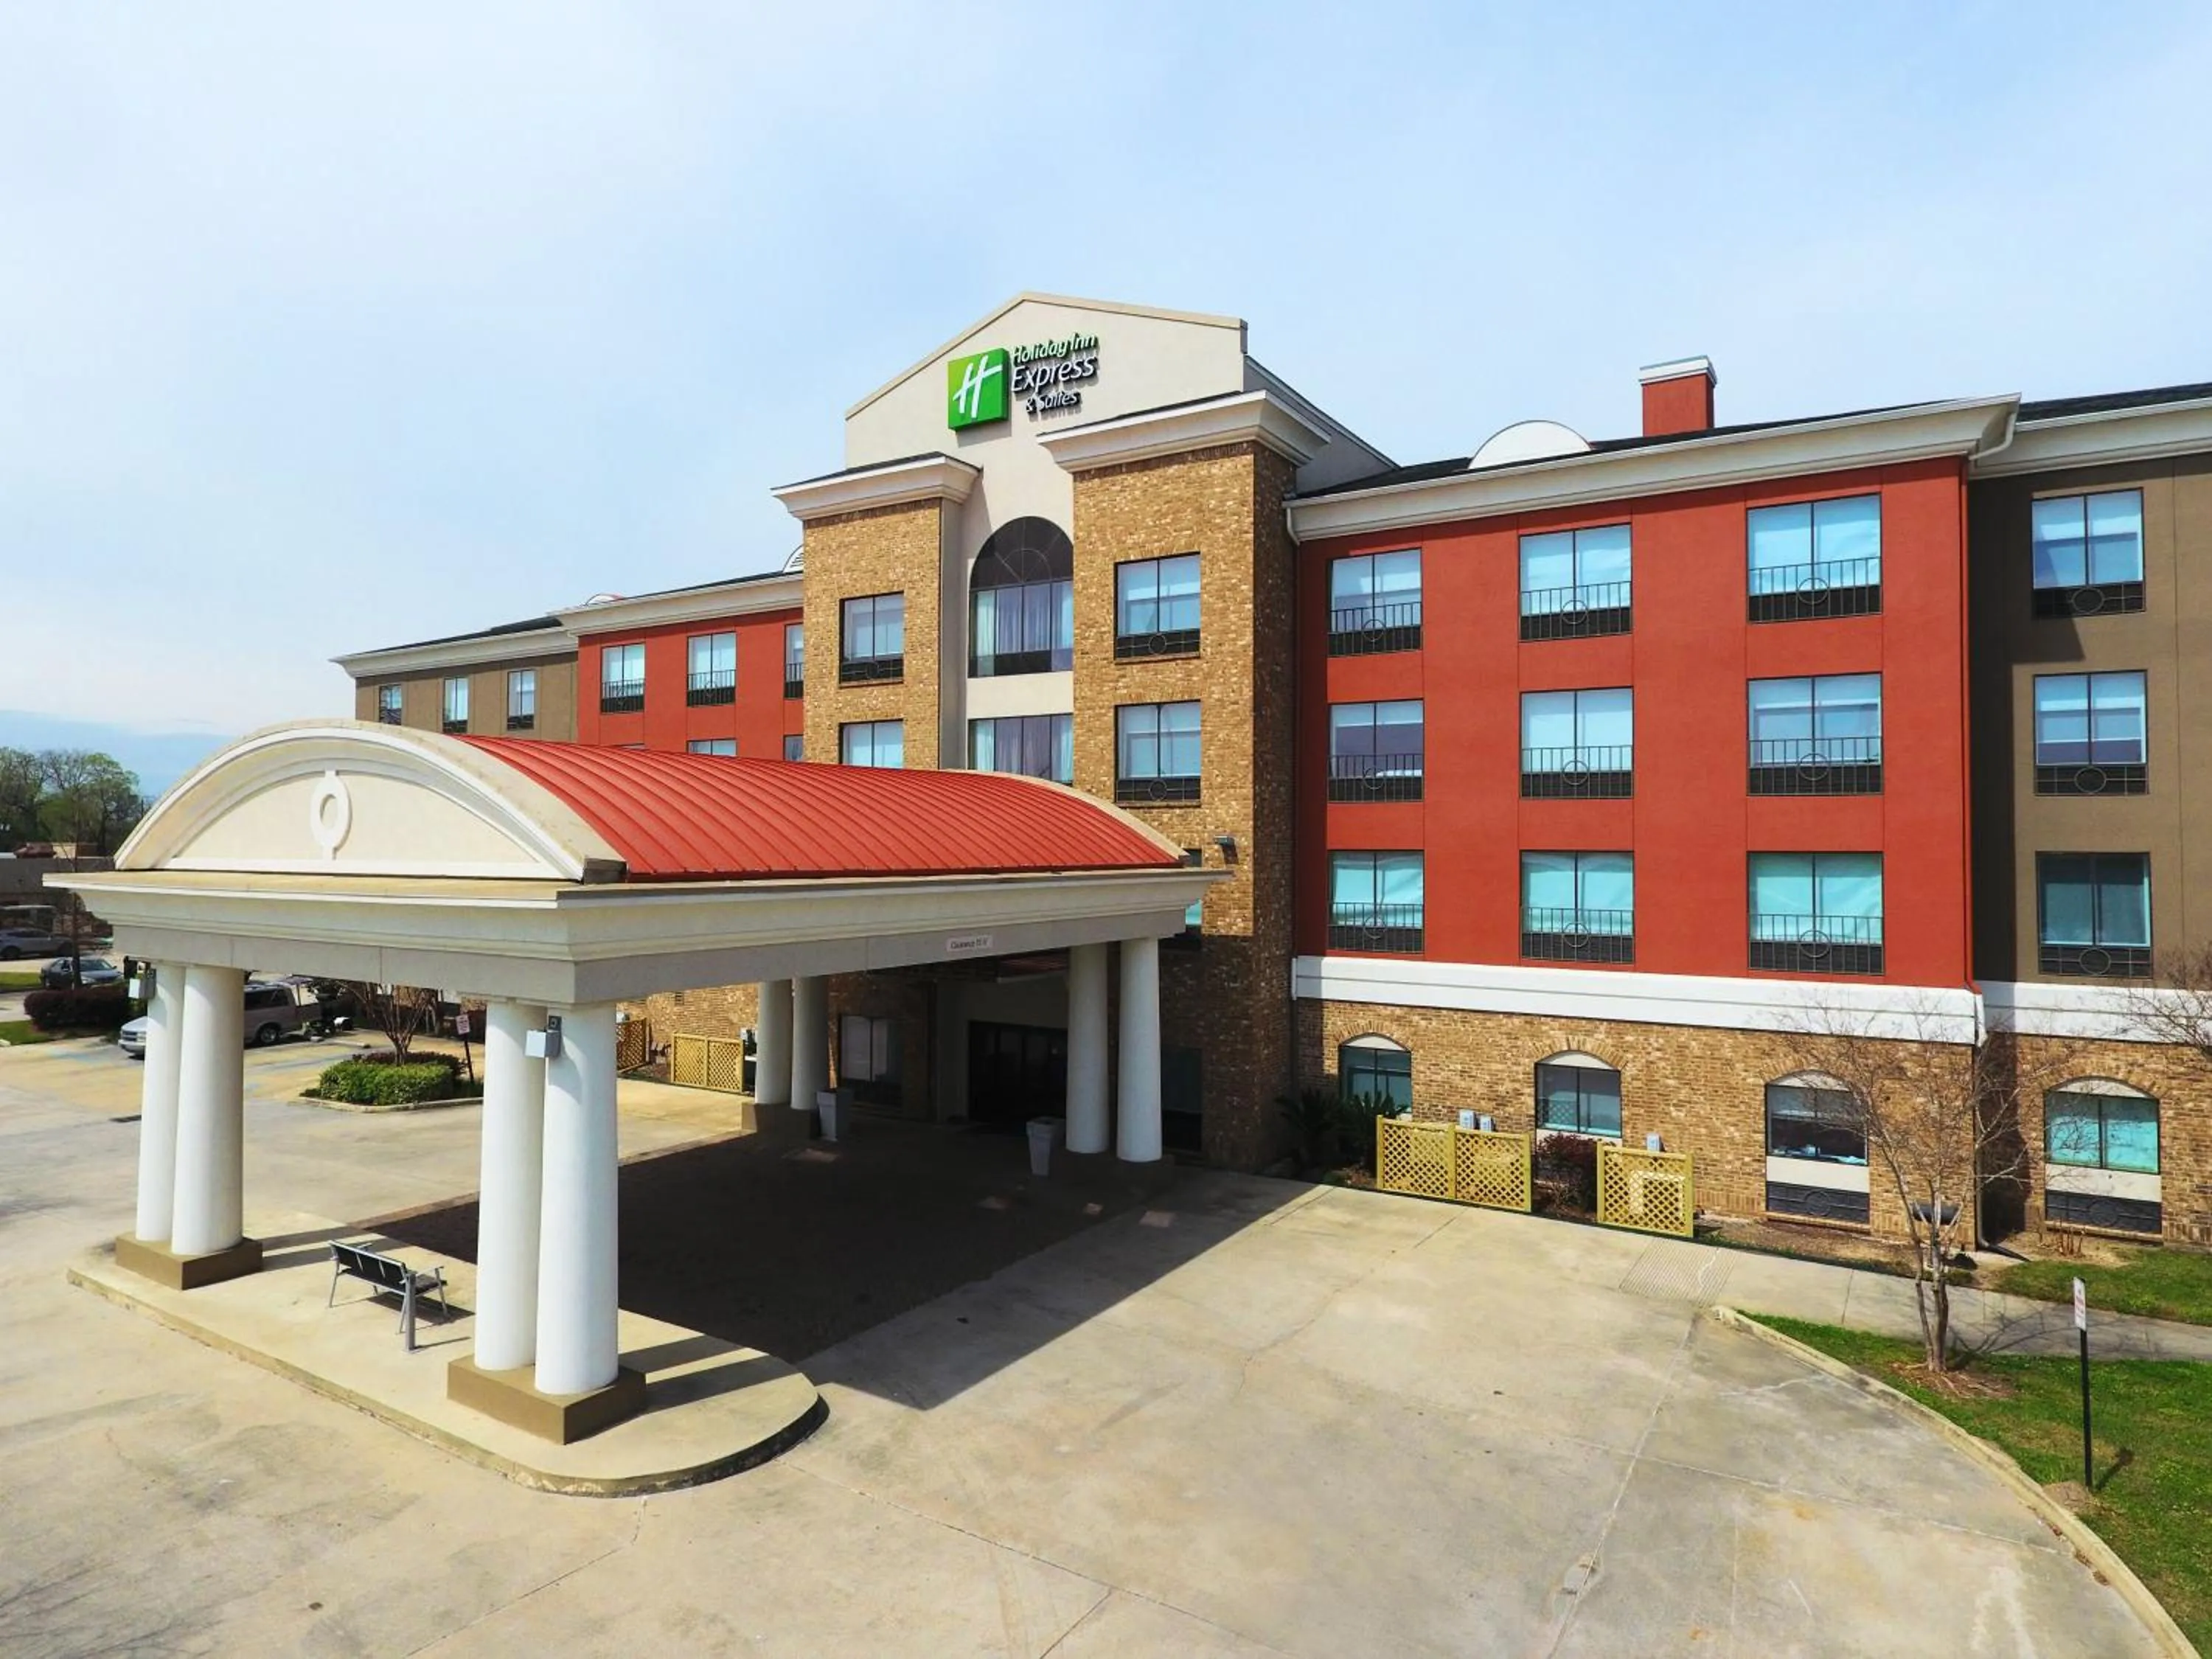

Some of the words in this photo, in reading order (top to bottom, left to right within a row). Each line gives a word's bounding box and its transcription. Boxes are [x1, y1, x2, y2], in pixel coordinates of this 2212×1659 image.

[1012, 339, 1068, 364] Holiday
[1071, 333, 1097, 349] Inn
[953, 355, 1002, 418] H
[1012, 357, 1096, 393] Express
[1026, 397, 1035, 413] &
[1036, 390, 1079, 411] Suites
